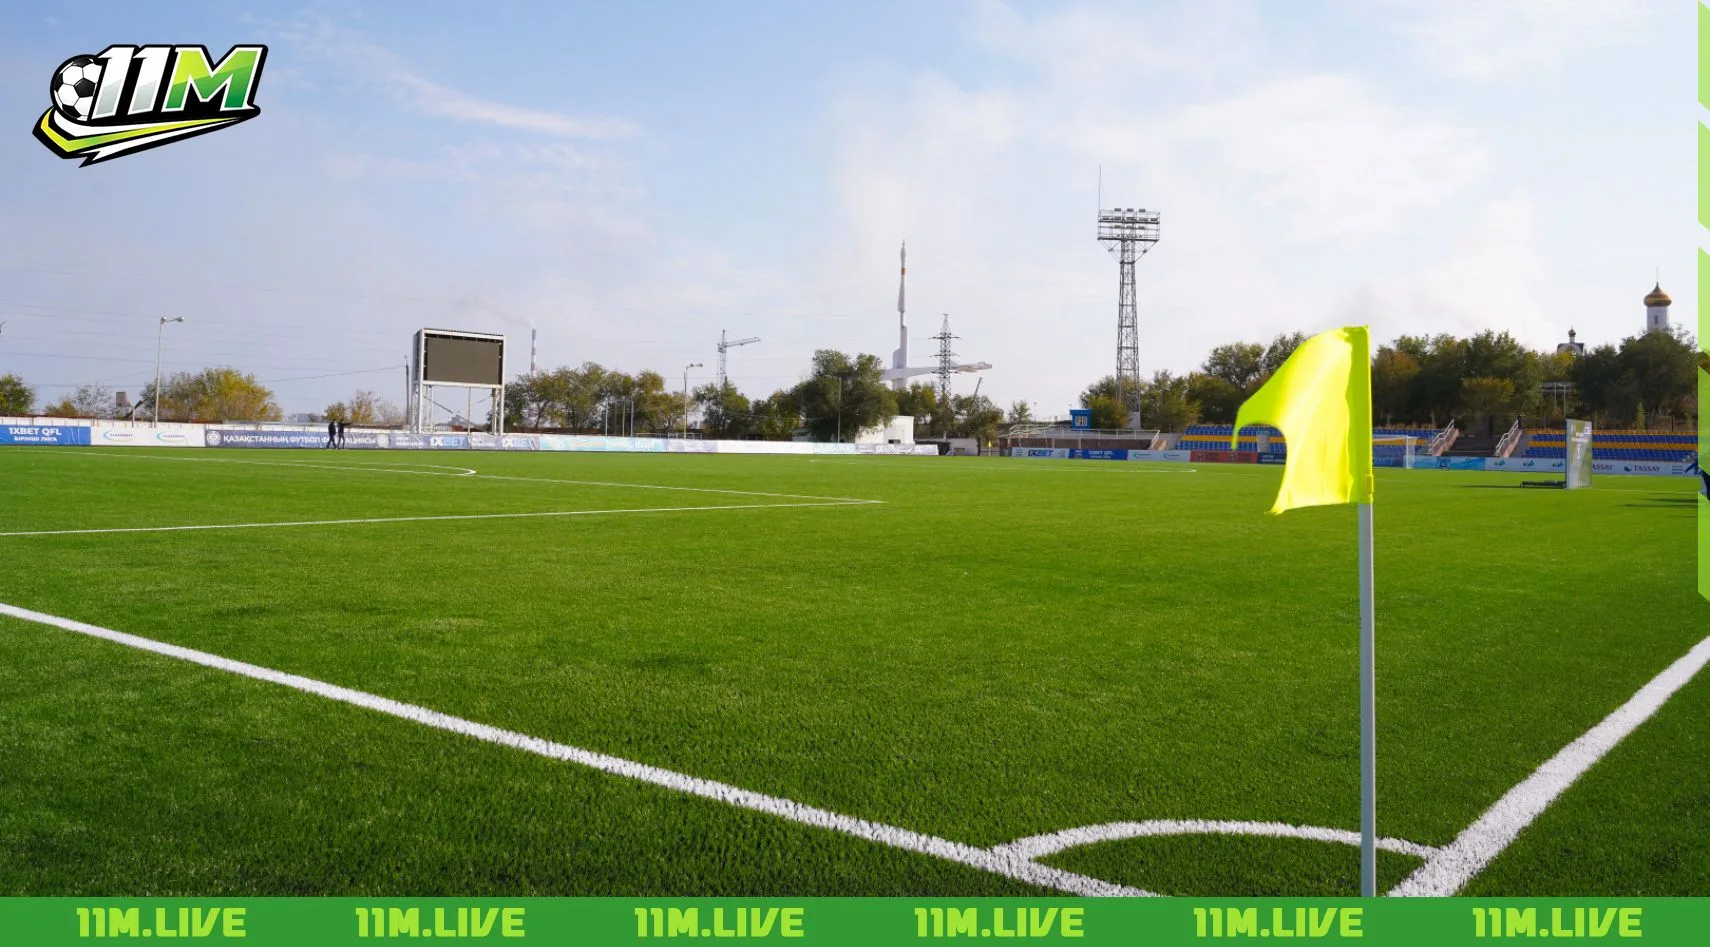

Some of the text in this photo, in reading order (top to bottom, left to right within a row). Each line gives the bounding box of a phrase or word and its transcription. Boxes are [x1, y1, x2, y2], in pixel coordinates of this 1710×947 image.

[8, 427, 62, 437] 1XBET QFL
[223, 435, 289, 444] ҚАЗАҚСТАННЫҢ
[290, 436, 320, 444] ФУТБОЛ
[430, 436, 469, 447] 1XBET
[1028, 449, 1054, 457] 1XBET
[1592, 463, 1613, 471] ASSAY
[1633, 464, 1660, 473] TASSAY
